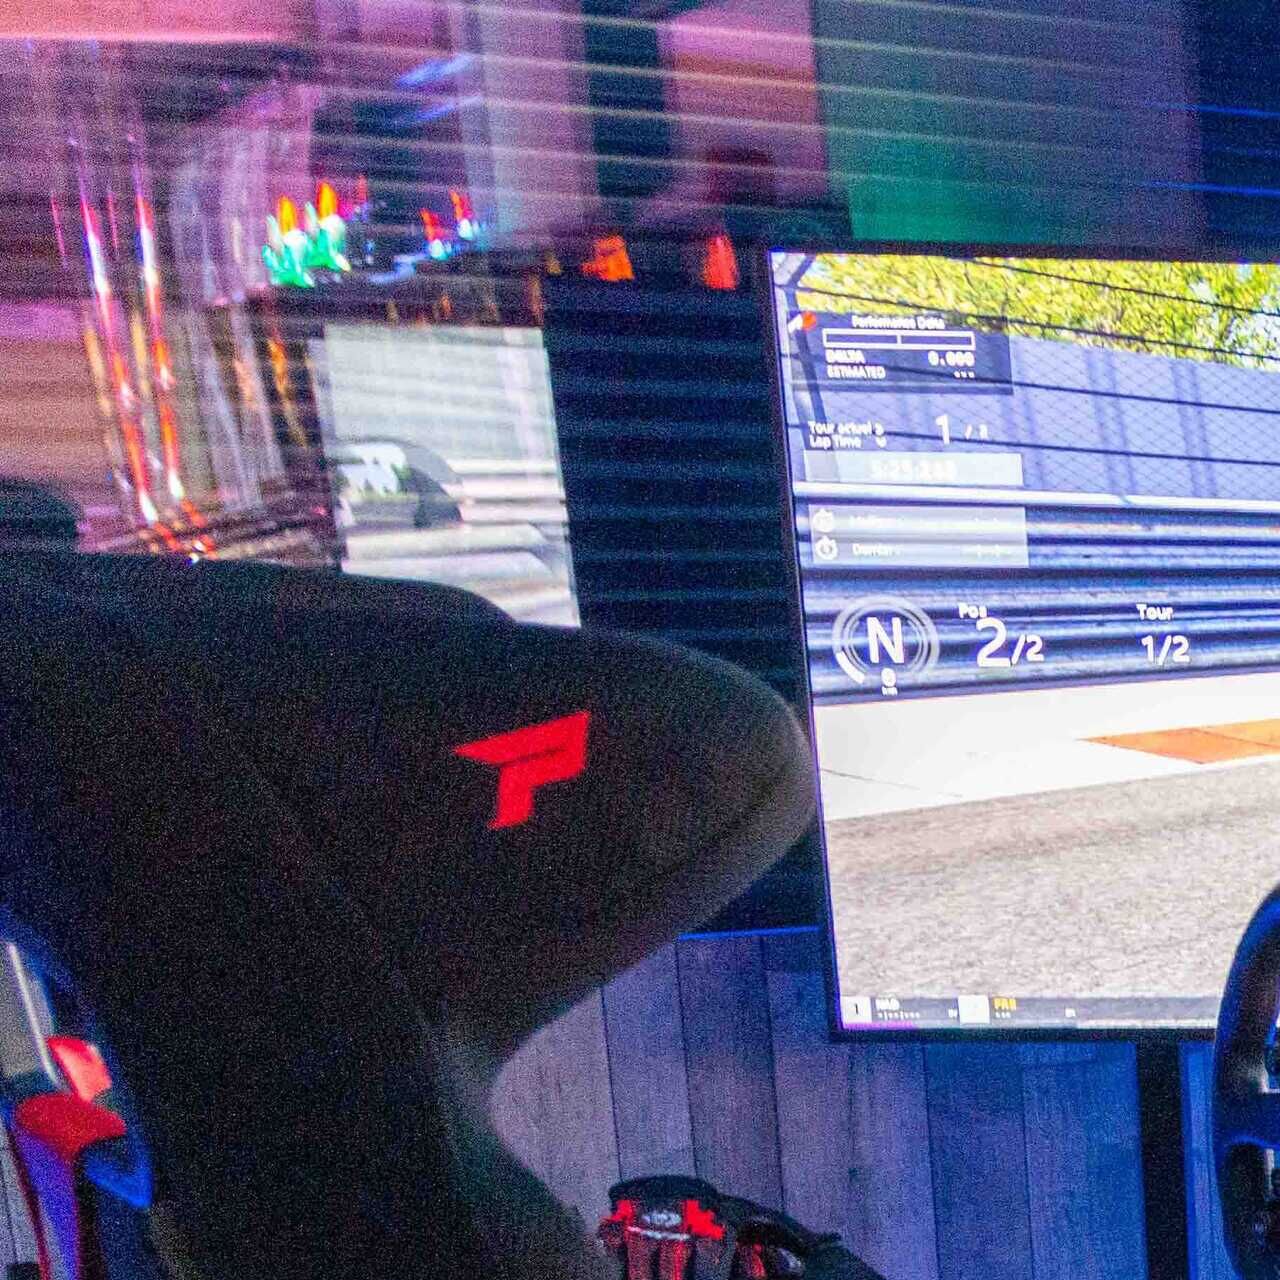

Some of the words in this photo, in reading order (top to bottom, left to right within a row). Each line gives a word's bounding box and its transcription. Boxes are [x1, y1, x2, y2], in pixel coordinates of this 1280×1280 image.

[810, 435, 832, 449] Lap
[834, 435, 862, 449] Time
[958, 602, 987, 619] Pos
[1135, 603, 1174, 620] Tour
[866, 616, 905, 664] N
[975, 618, 1045, 668] 2/2
[1141, 634, 1191, 666] 1/2
